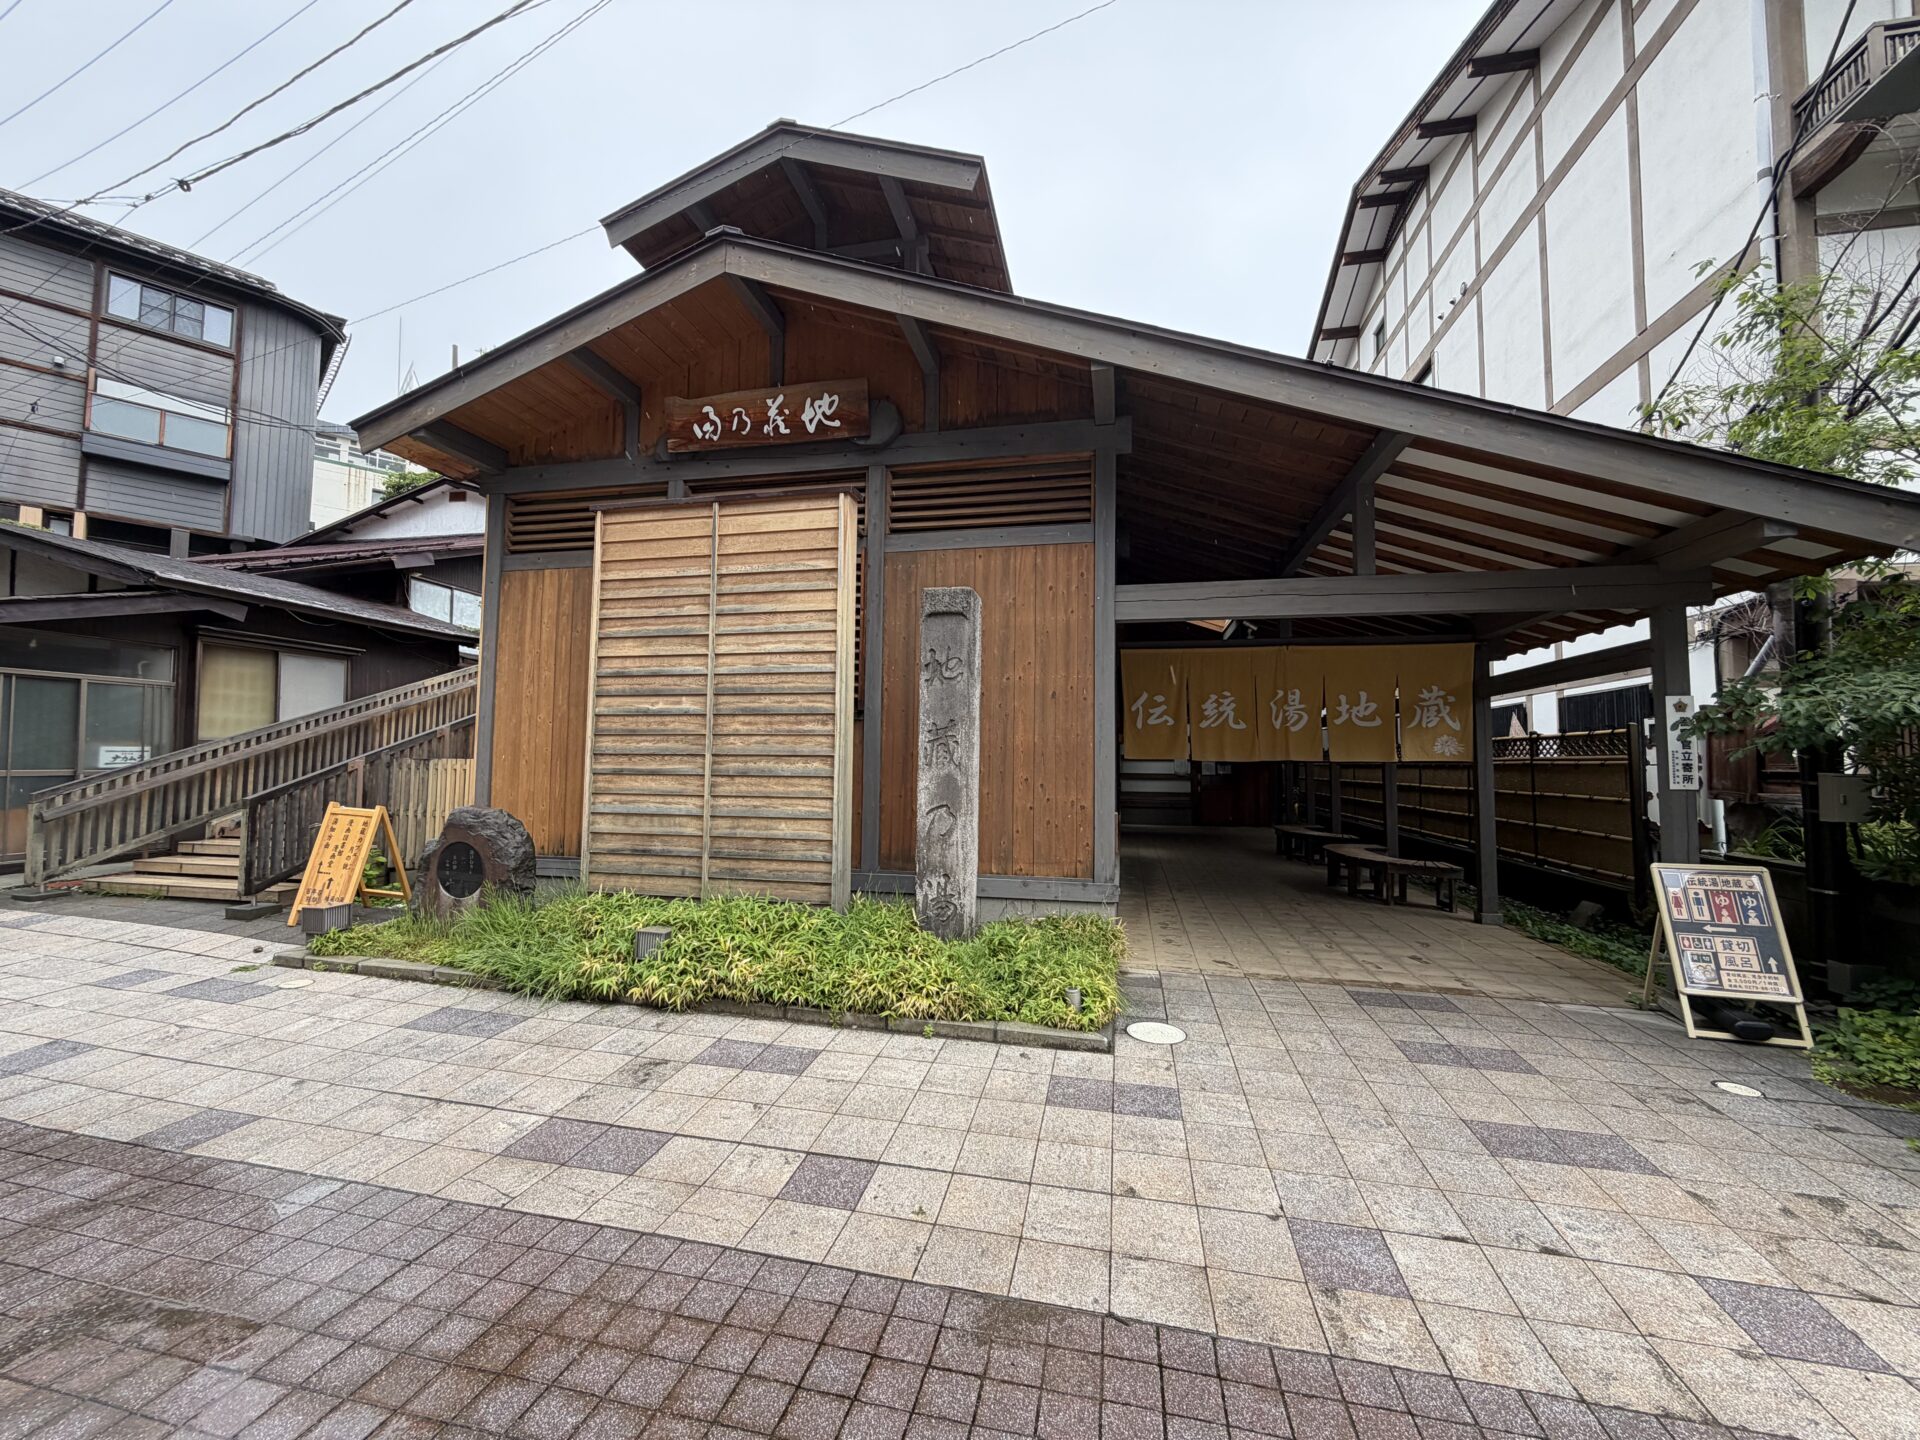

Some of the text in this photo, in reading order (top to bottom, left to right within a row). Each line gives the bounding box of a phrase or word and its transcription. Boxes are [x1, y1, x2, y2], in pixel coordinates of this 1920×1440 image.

[1131, 685, 1462, 732] 伝統湯地蔵
[1714, 895, 1729, 907] ゆ
[1742, 896, 1757, 908] ゆ
[1720, 939, 1750, 952] 貸切
[1724, 956, 1753, 968] 風呂
